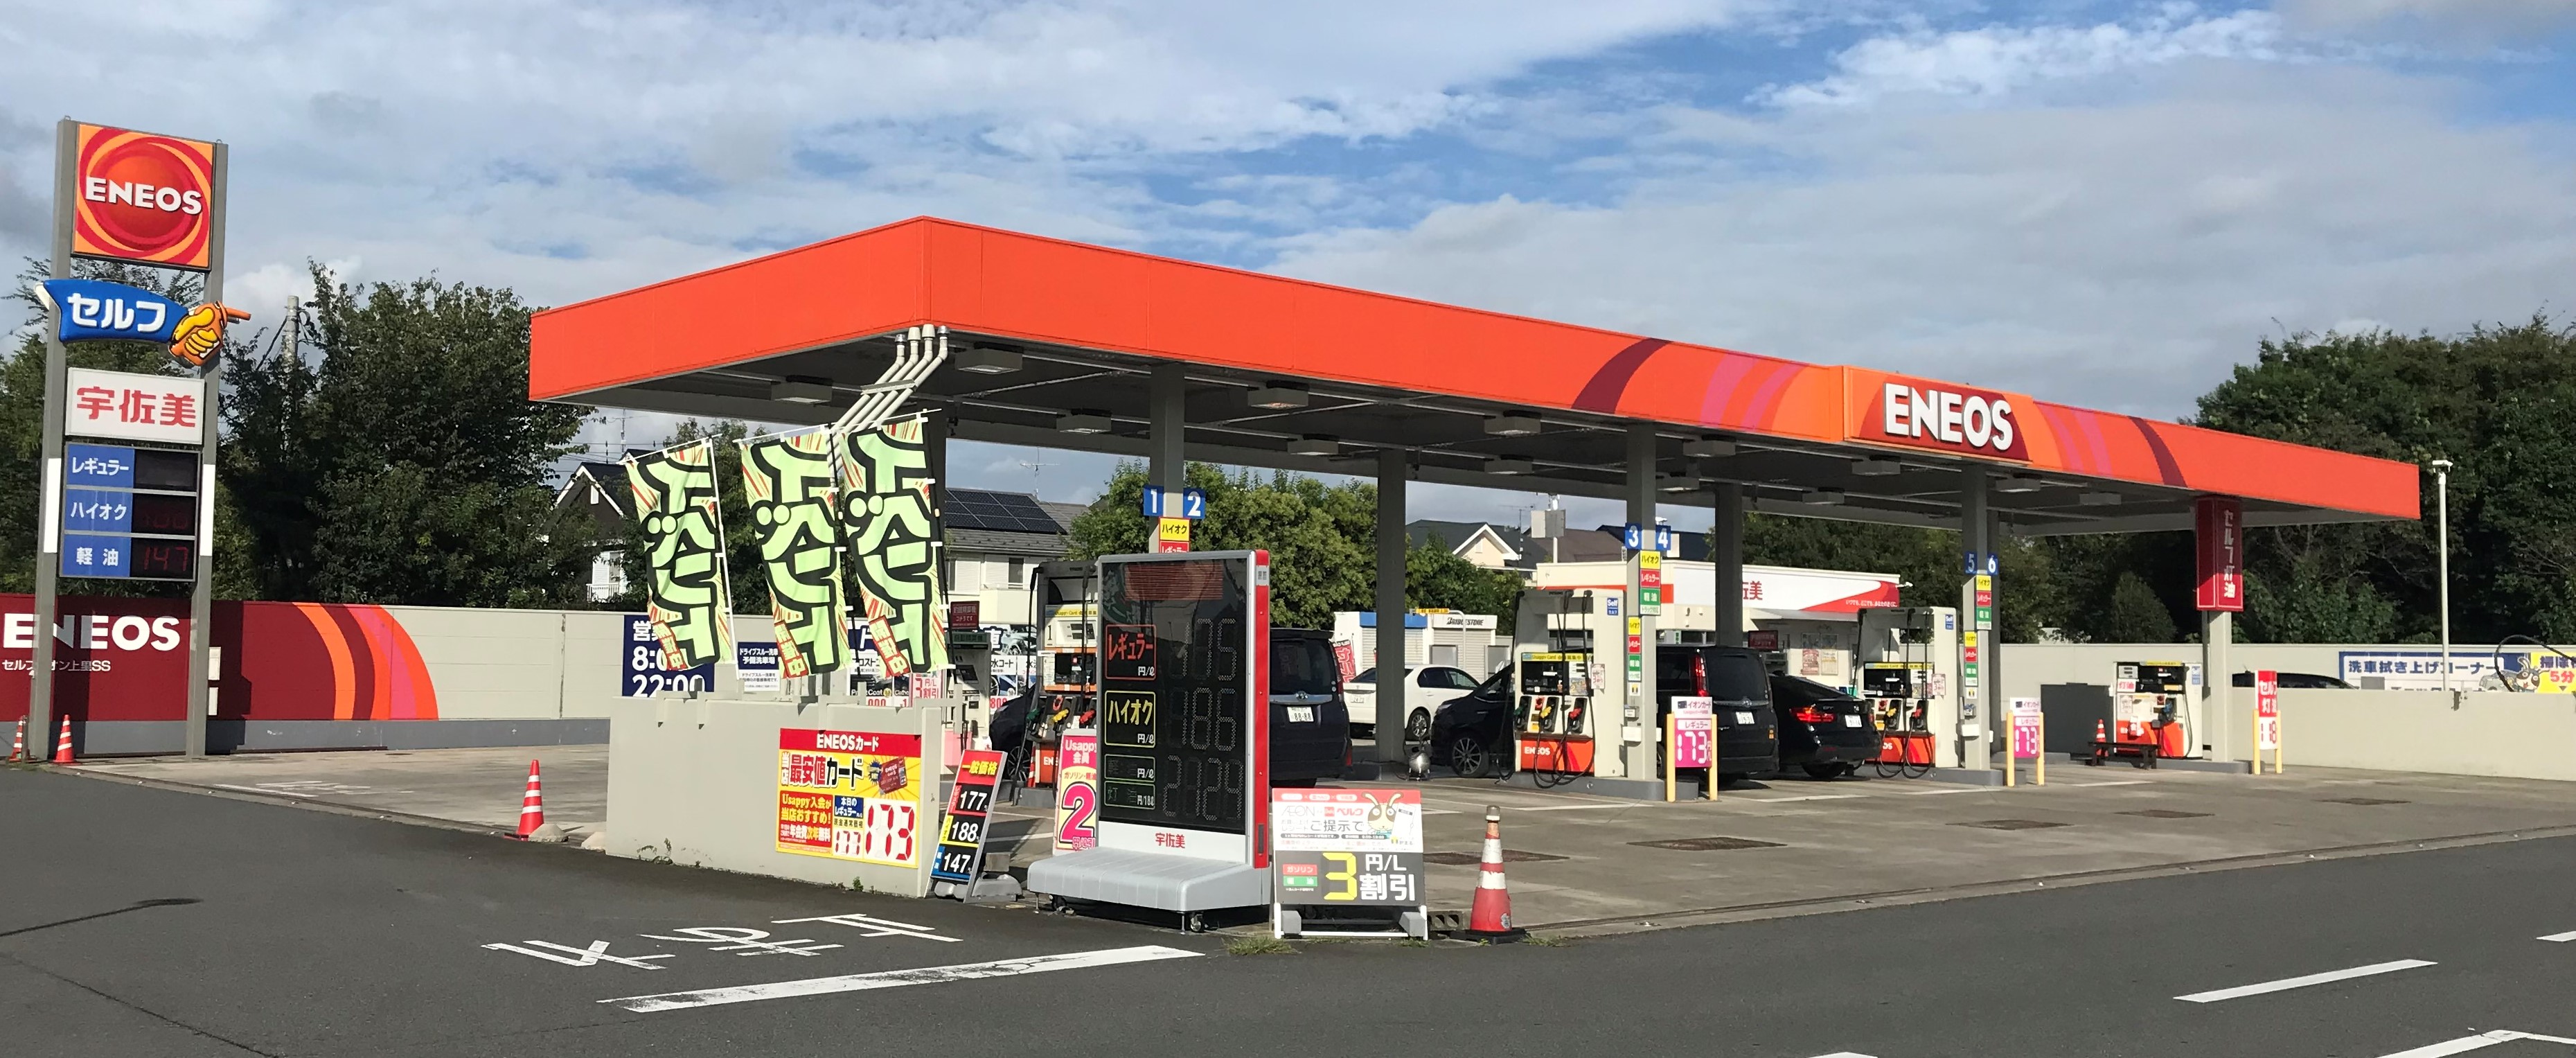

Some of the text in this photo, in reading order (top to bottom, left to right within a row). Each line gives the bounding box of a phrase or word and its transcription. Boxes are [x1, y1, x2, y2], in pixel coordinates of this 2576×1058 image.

[85, 176, 202, 215] ENEOS
[67, 292, 166, 333] セルフ
[77, 386, 196, 427] 宇佐美
[1884, 382, 2014, 451] ENEOS
[72, 457, 130, 476] レギュラー
[71, 502, 127, 520] ハイオク
[1151, 488, 1157, 513] 1
[1187, 491, 1201, 516] 2
[1162, 524, 1187, 534] ハイオク
[1628, 524, 1639, 547] 3
[1658, 527, 1669, 548] 4
[76, 546, 189, 572] 軽油 147
[1641, 555, 1660, 565] ハイオク
[1968, 554, 1974, 572] 5
[2224, 509, 2235, 598] セルフ灯油
[1987, 556, 1996, 574] 6
[1641, 572, 1660, 584] レギュラー
[1644, 592, 1658, 601] 軽油
[3, 612, 181, 651] ENEOS
[1048, 624, 1053, 640] 1
[1108, 633, 1154, 660] レギュラー
[2348, 660, 2498, 674] 洗車拭き上げコーナー
[2550, 671, 2575, 683] 5分
[1108, 699, 1153, 725] ハイオク
[817, 733, 879, 752] ENEOSカード
[1677, 731, 1707, 764] 173
[2015, 726, 2037, 755] 173
[961, 760, 997, 776] 一般価格
[1073, 752, 1090, 764] 会員
[790, 754, 863, 788] 最安値カード
[835, 806, 857, 816] レギュラー
[840, 796, 858, 807] 本日の
[960, 791, 988, 811] 177
[781, 806, 831, 825] 当店おすすめ！
[1059, 781, 1097, 845] 2
[866, 803, 915, 861] 173
[952, 821, 979, 843] 188
[1311, 819, 1365, 832] ご提示で
[835, 830, 861, 856] 177
[1155, 832, 1186, 849] 宇佐美
[943, 852, 971, 874] 147
[1322, 852, 1407, 901] 3 円/L
[1359, 874, 1416, 901] 割引
